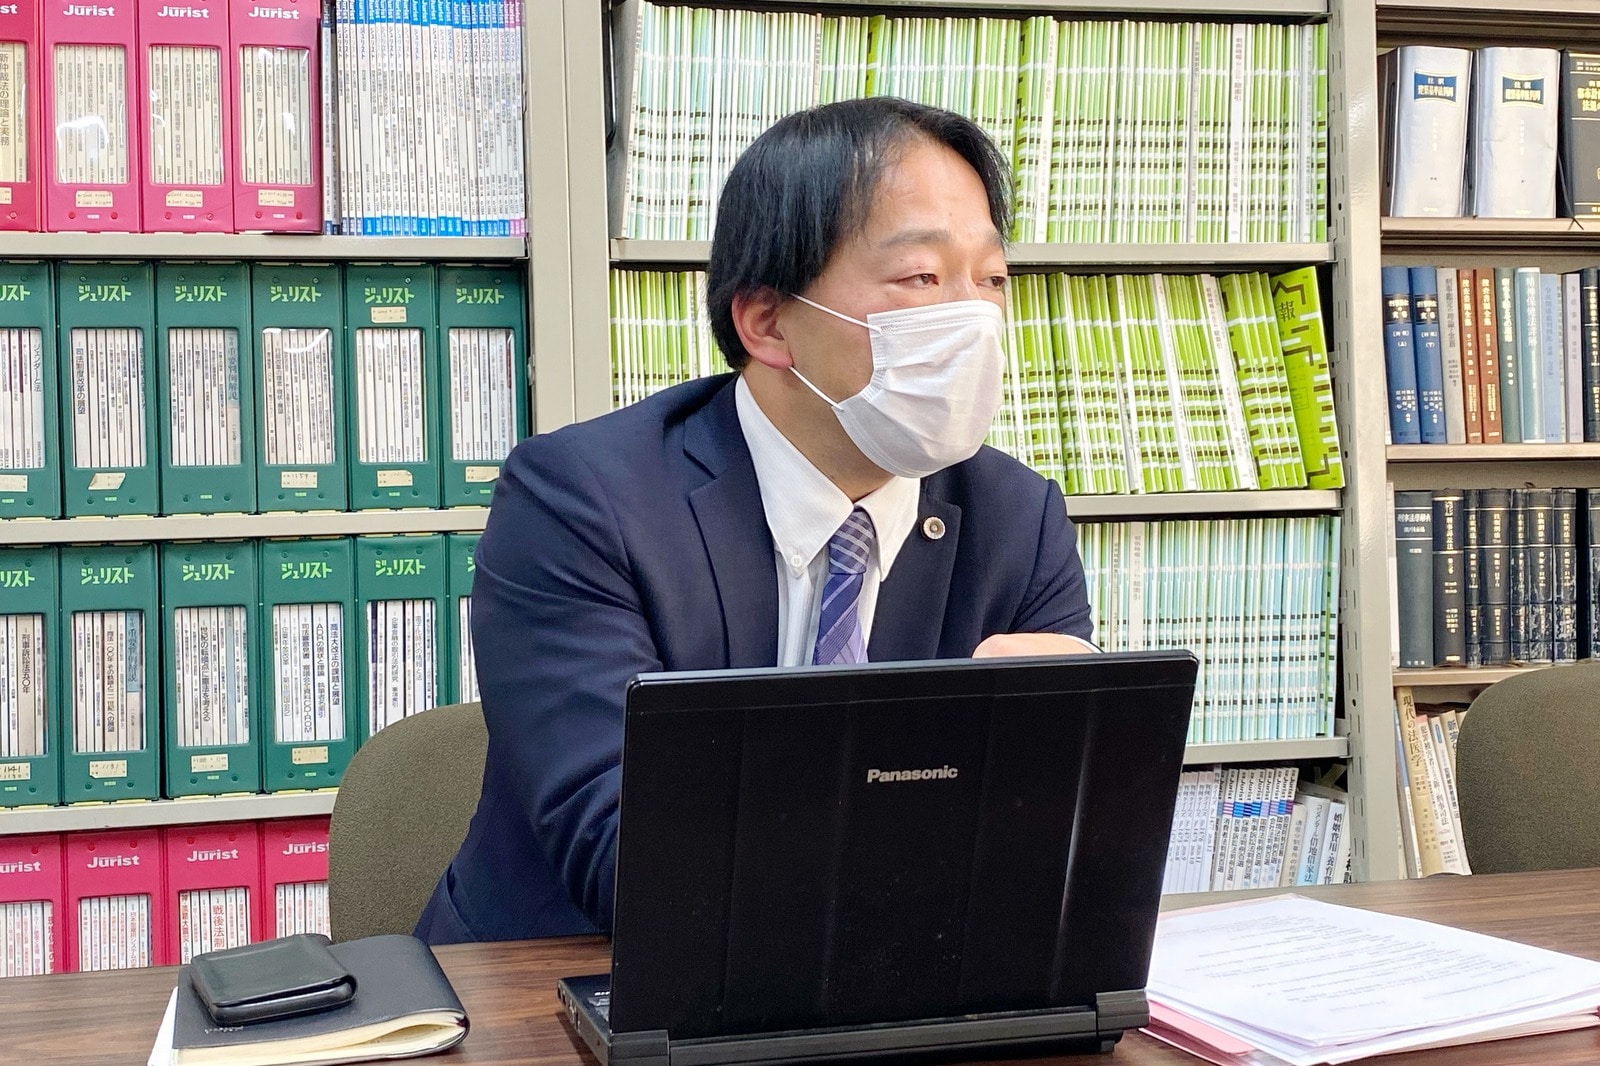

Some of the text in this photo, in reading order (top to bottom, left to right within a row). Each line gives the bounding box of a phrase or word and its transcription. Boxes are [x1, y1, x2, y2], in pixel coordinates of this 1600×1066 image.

[63, 5, 115, 16] Jurist
[157, 6, 209, 18] Jurist
[248, 7, 299, 19] Jurist
[0, 285, 30, 301] リスト
[78, 285, 131, 302] ジュリスト
[175, 286, 227, 302] ジュリスト
[270, 286, 321, 303] ジュリスト
[365, 287, 414, 304] ジュリスト
[456, 288, 504, 304] ジュリスト
[81, 567, 134, 585] ジュリスト
[182, 564, 235, 582] ジュリスト
[281, 562, 332, 579] ジュリスト
[375, 559, 426, 576] ジュリスト
[0, 570, 35, 587] リスト
[1403, 695, 1422, 766] 現代の法医学
[867, 765, 958, 783] Panasonic
[87, 855, 140, 868] Jurist
[187, 849, 239, 863] Jurist
[0, 862, 41, 873] urist
[213, 905, 224, 952] 戦後法制
